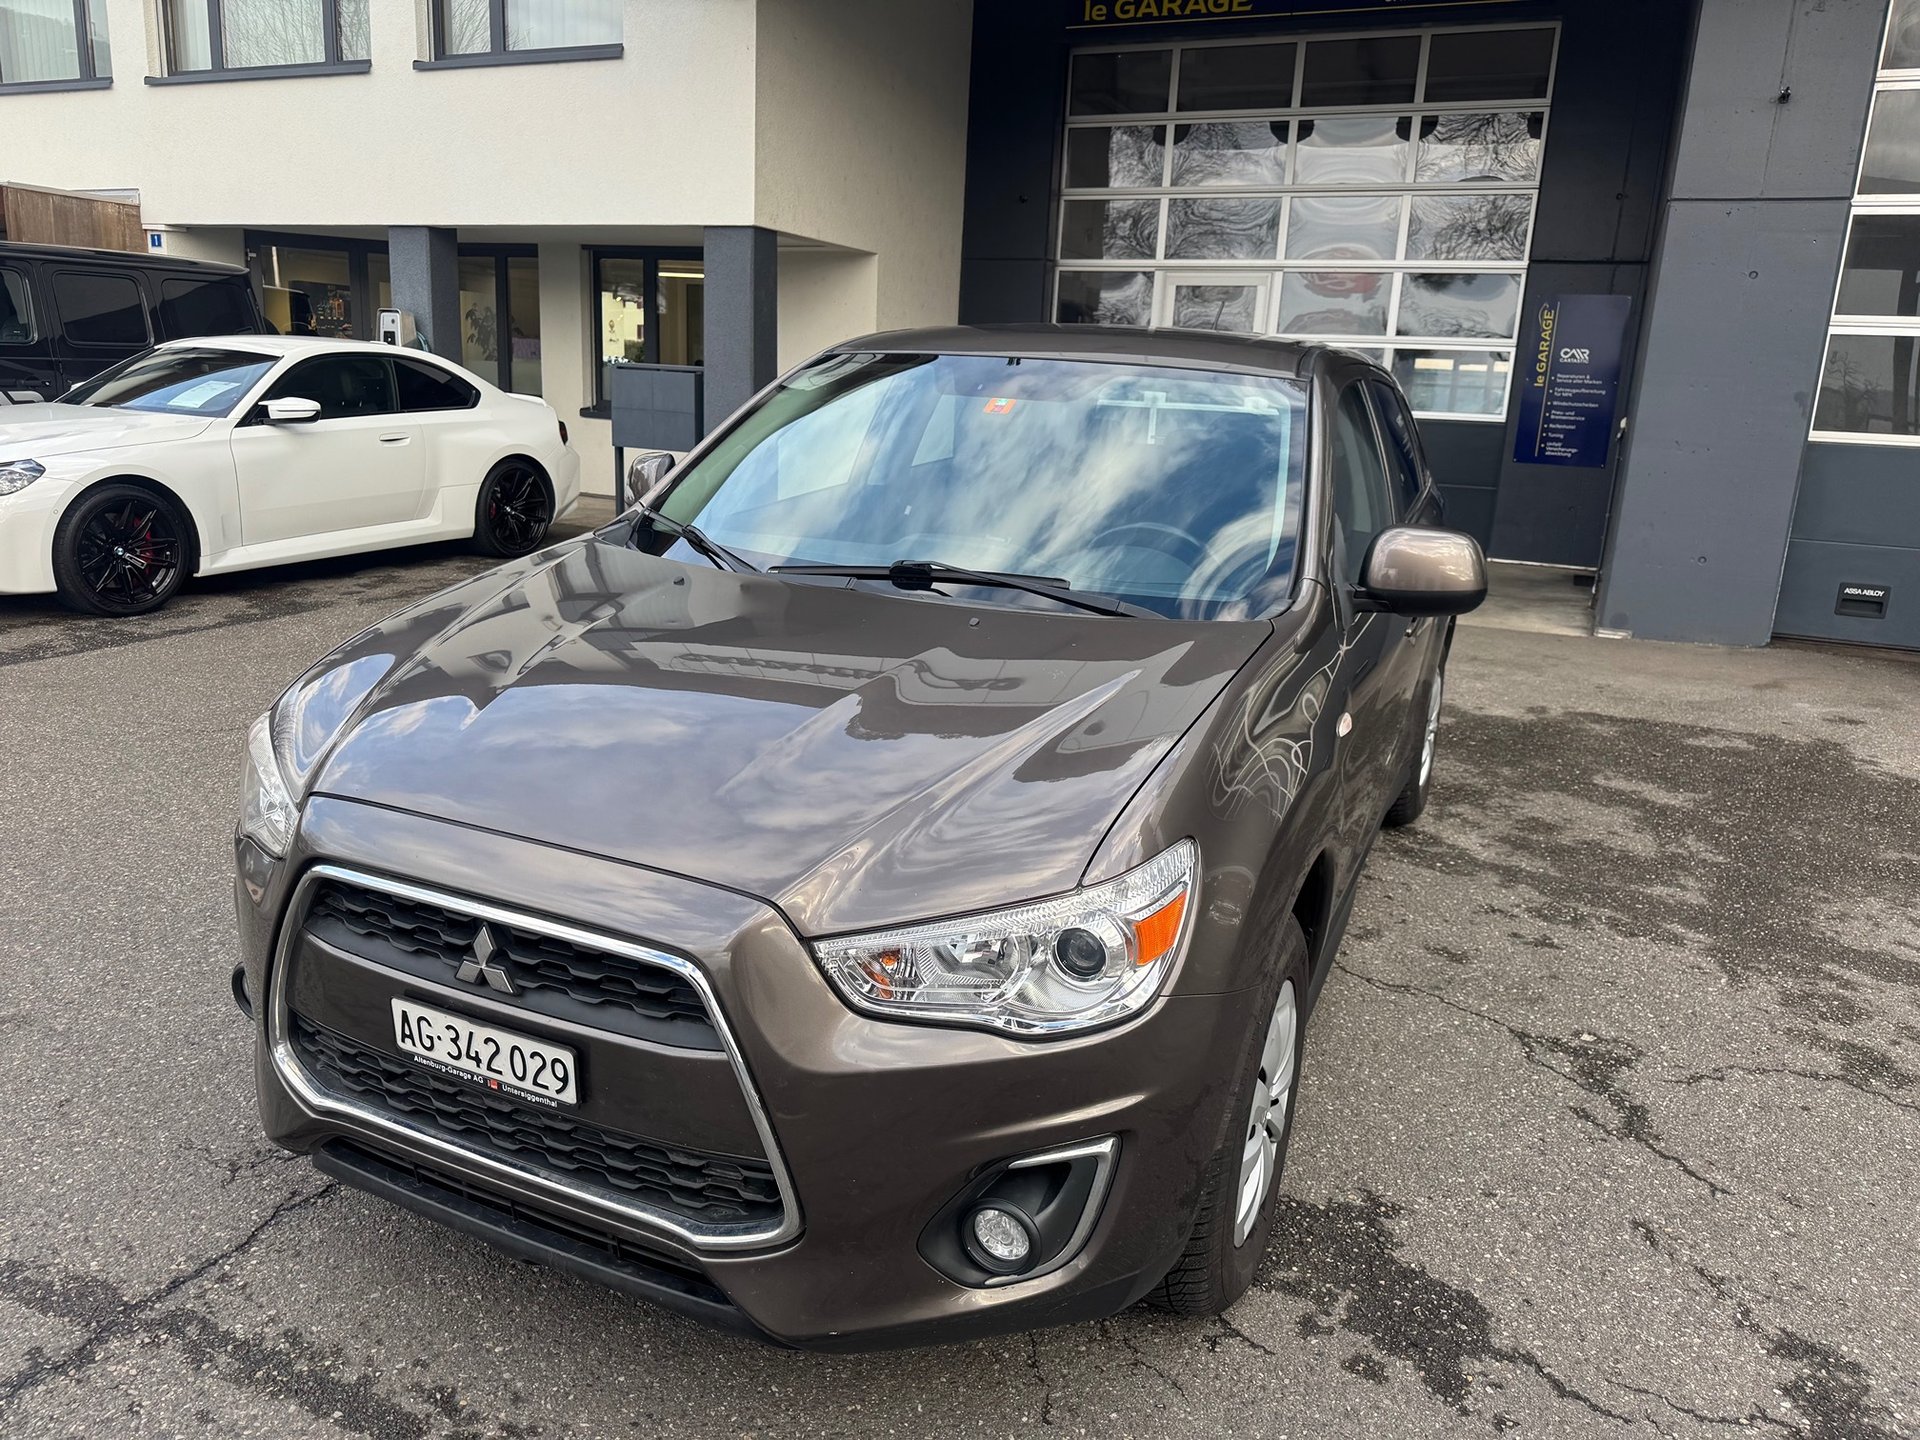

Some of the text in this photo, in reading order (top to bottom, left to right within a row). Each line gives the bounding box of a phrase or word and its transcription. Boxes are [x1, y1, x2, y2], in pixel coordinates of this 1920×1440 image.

[1084, 0, 1252, 21] le GARAGE
[1534, 310, 1554, 386] le GARAGE
[414, 1055, 484, 1084] Altenburg-Garage AG
[502, 1084, 558, 1108] Untersiggenthal
